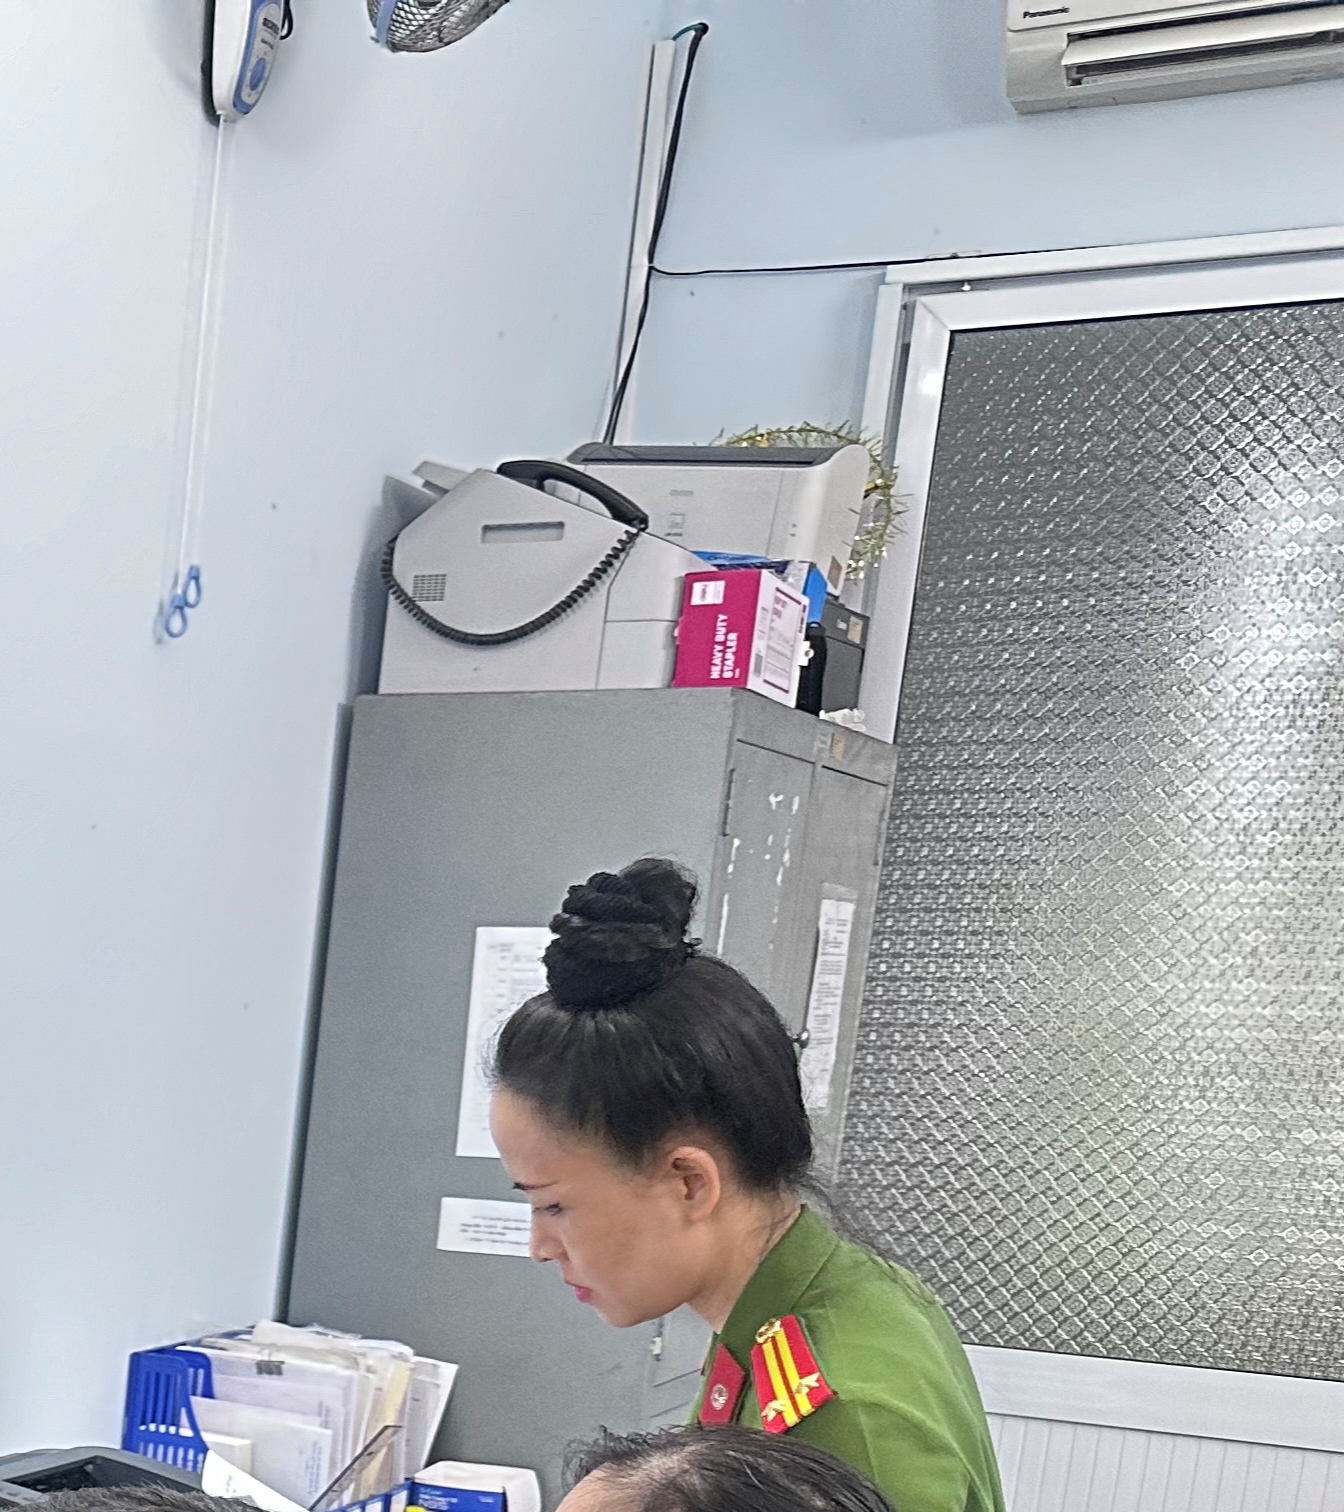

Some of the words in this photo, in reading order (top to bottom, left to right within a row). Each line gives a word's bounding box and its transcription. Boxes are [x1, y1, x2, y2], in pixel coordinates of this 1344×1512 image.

[715, 614, 728, 642] DUTY
[710, 645, 723, 678] HEAVY
[723, 633, 738, 678] STAPLER
